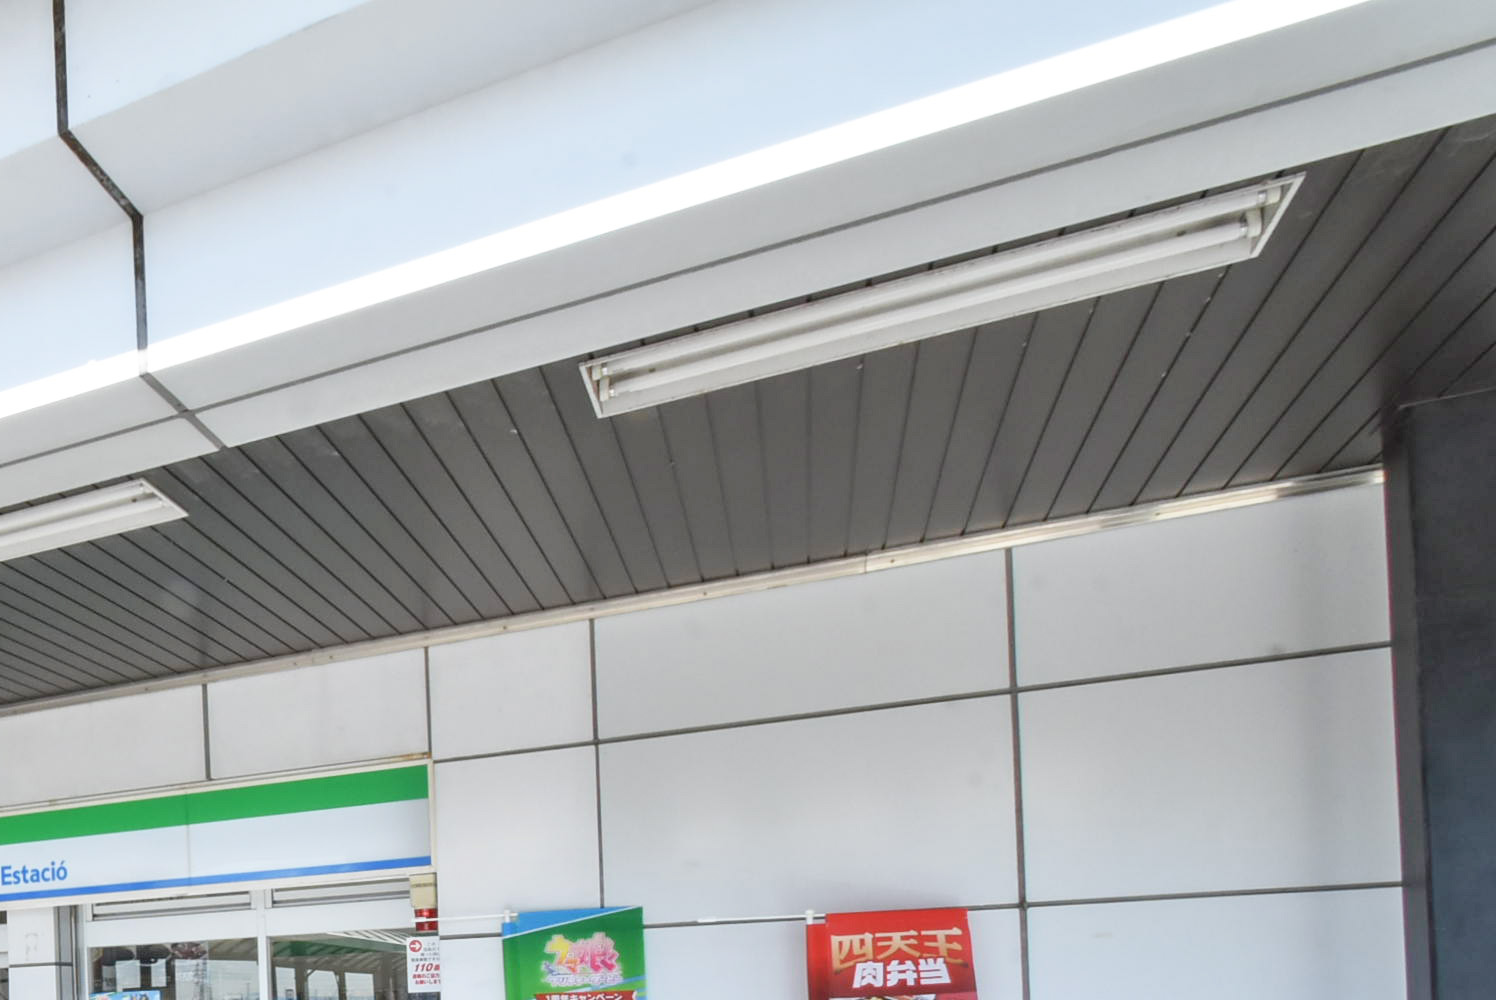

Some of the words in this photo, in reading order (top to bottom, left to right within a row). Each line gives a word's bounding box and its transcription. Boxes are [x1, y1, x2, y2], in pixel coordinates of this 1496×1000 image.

[0, 860, 68, 886] Estació
[830, 927, 969, 974] 四天王
[852, 958, 951, 988] 肉弁当
